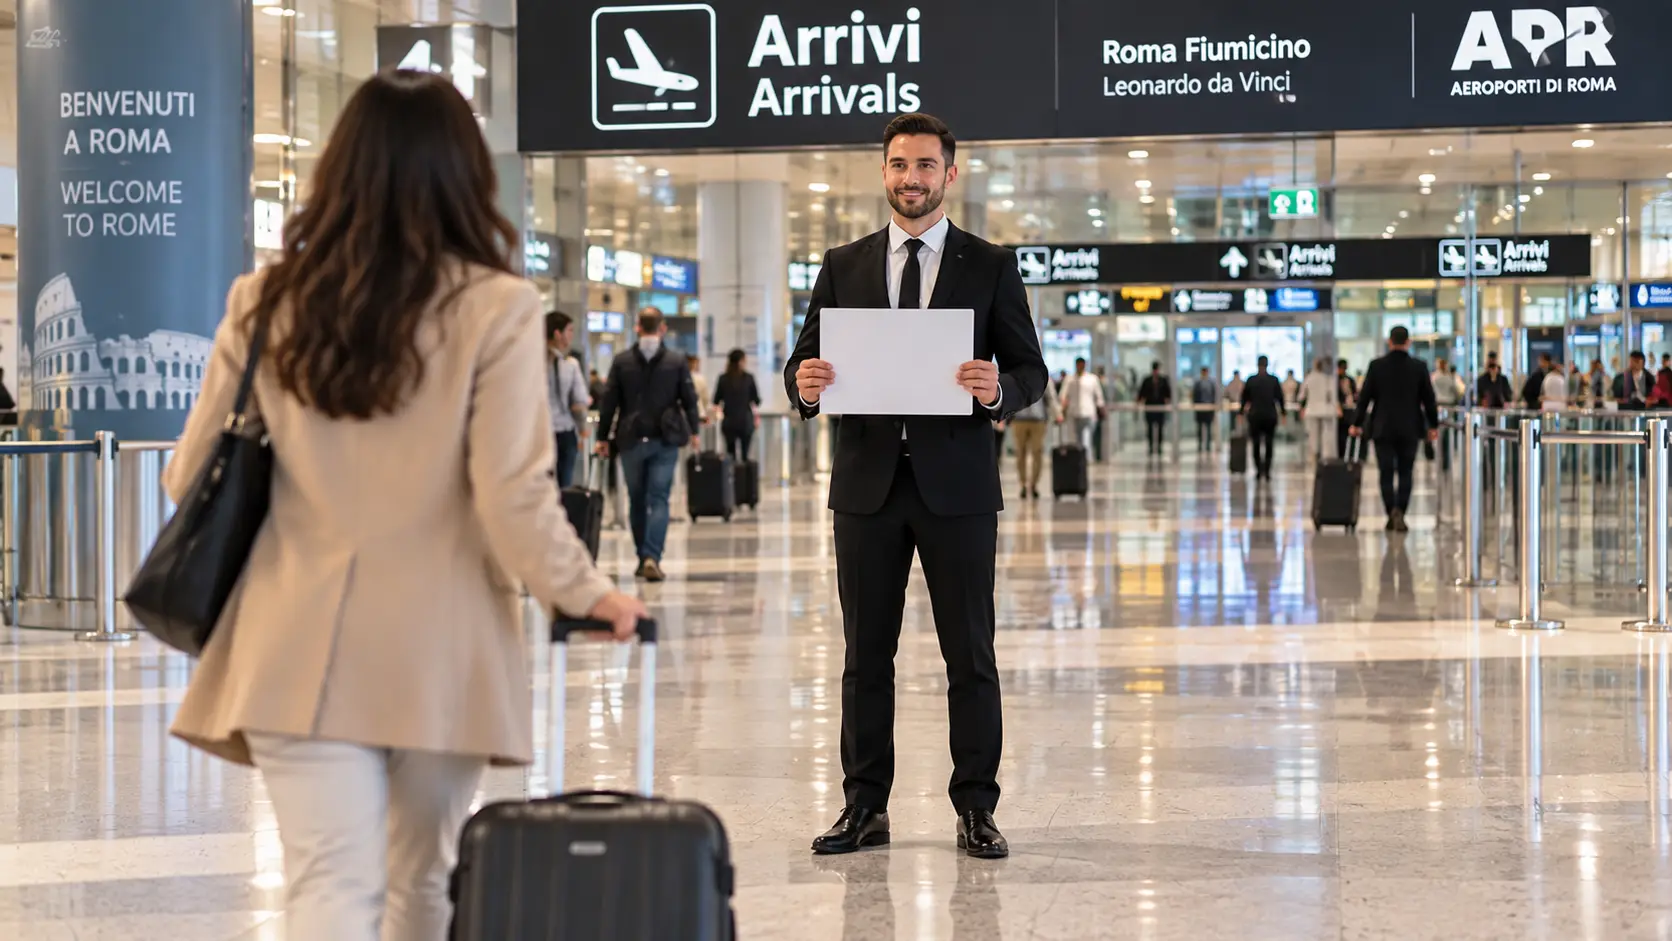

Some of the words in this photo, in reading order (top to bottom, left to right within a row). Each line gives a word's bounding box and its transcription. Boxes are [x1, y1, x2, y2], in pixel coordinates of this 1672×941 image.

[747, 7, 921, 68] Arrivi
[1103, 39, 1177, 64] Roma
[1185, 33, 1311, 62] Fiumicino
[747, 72, 921, 117] Arrivals
[1103, 73, 1202, 96] Leonardo
[1207, 72, 1233, 95] da
[1239, 70, 1291, 92] Vinci
[1450, 79, 1541, 96] AEROPORTI
[1546, 78, 1562, 93] DI
[1567, 77, 1617, 92] ROMA
[60, 91, 195, 118] BENVENUTI
[63, 129, 81, 155] A
[89, 128, 171, 154] ROMA
[60, 180, 182, 204] WELCOME
[62, 213, 94, 237] TO
[102, 212, 176, 237] ROME
[1503, 240, 1549, 259] Arrivi
